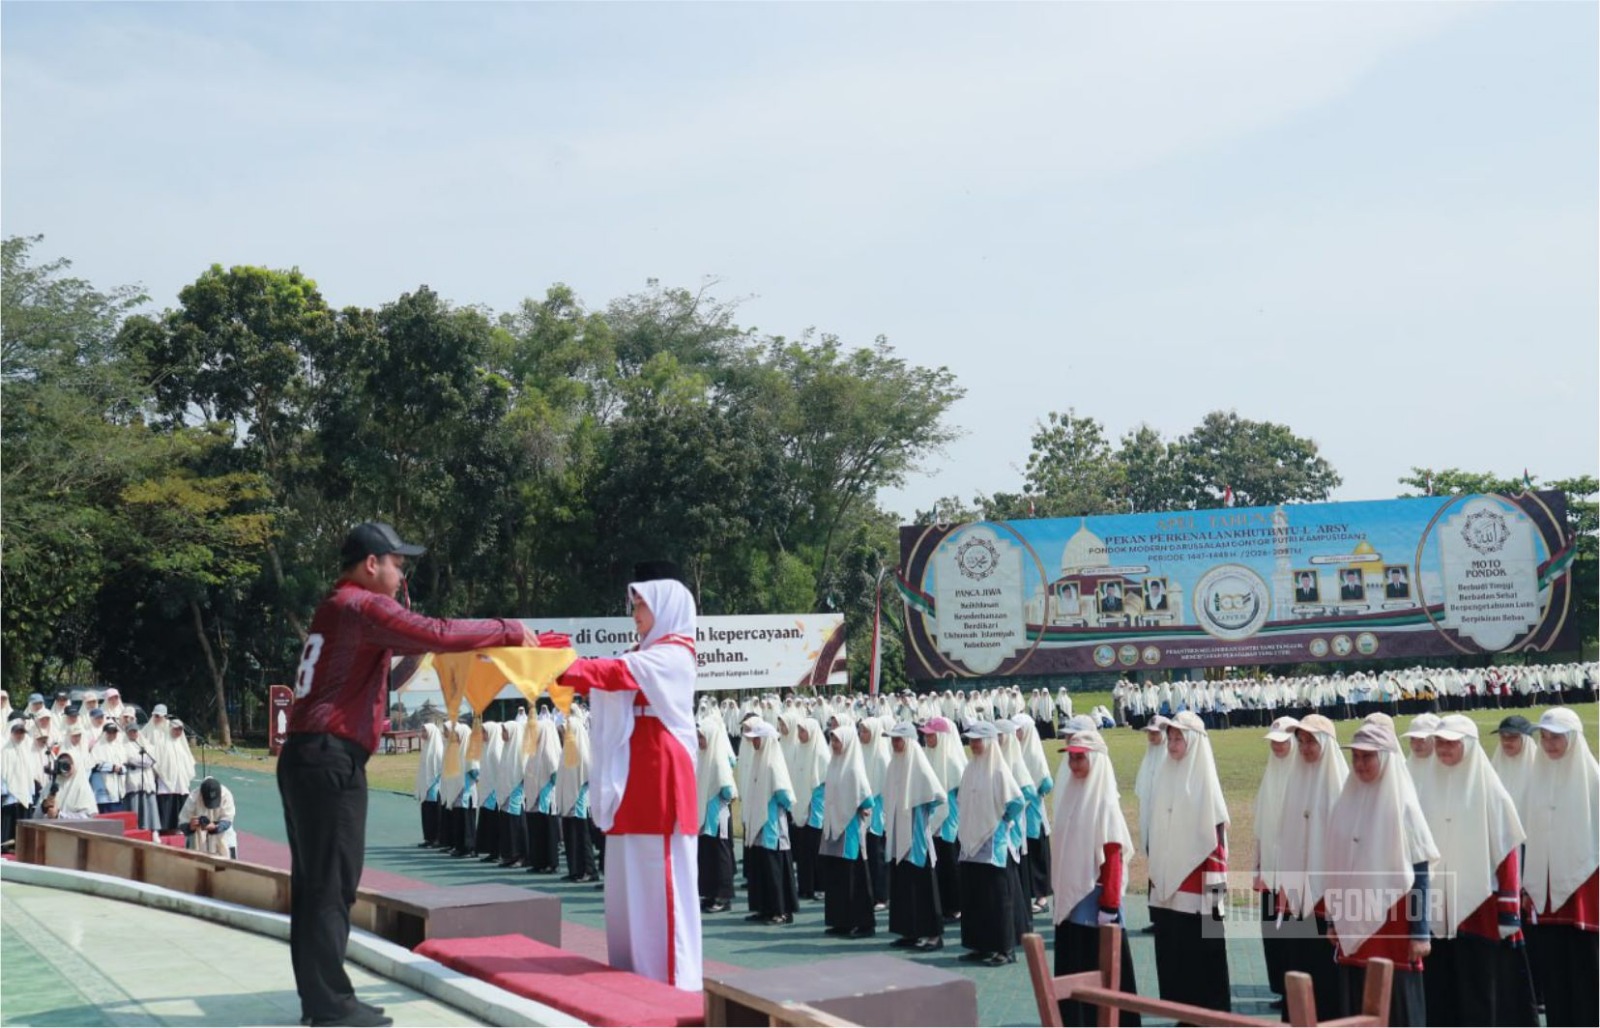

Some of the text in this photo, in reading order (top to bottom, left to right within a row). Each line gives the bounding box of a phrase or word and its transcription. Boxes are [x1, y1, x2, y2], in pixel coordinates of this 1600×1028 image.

[1105, 534, 1148, 546] PEKAN
[1088, 545, 1128, 555] PONDOK
[1129, 543, 1168, 553] MODERN
[1148, 553, 1184, 562] PERIODE
[1472, 559, 1501, 569] MOTO
[1465, 568, 1507, 578] PONDOK
[955, 588, 1002, 598] PANCA JIWA
[575, 629, 592, 644] di
[595, 629, 640, 644] Gonto
[708, 627, 804, 644] kepercayaan,
